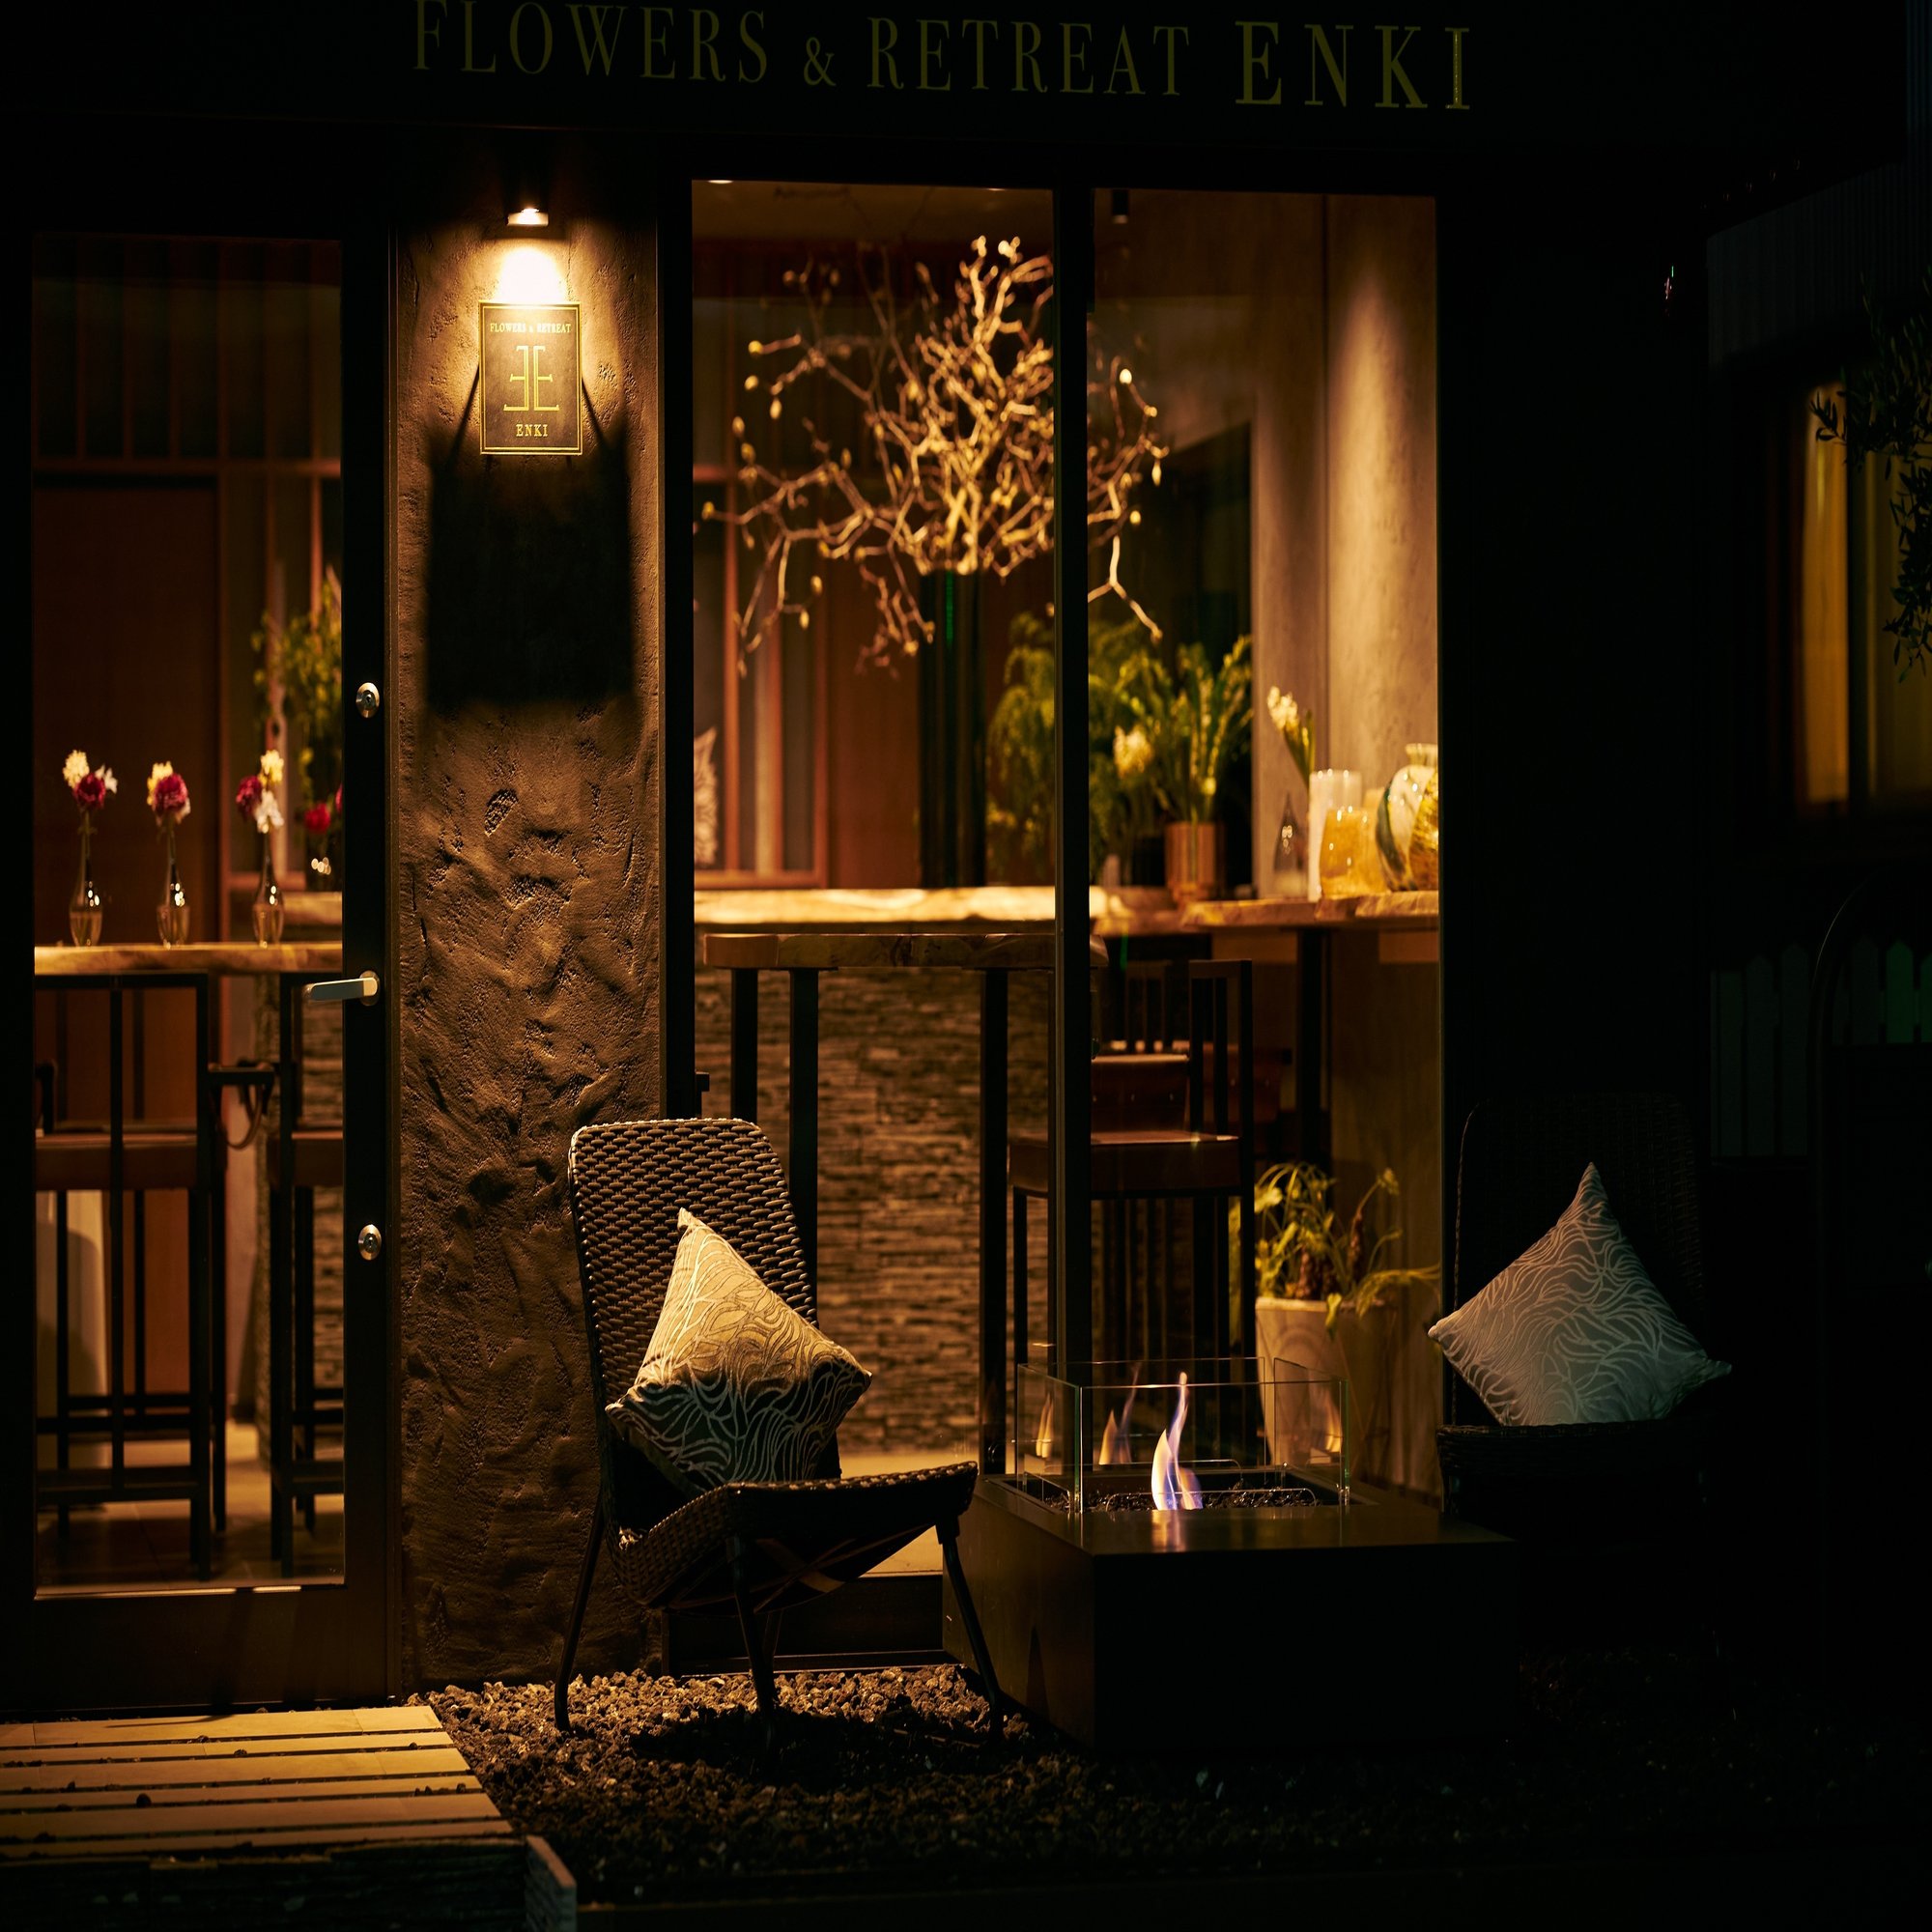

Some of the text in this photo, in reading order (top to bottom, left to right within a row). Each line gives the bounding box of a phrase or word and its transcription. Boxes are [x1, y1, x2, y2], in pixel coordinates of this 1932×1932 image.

[413, 0, 1473, 111] FLOWERS & RETREAT ENKI
[516, 423, 549, 438] ENKI
